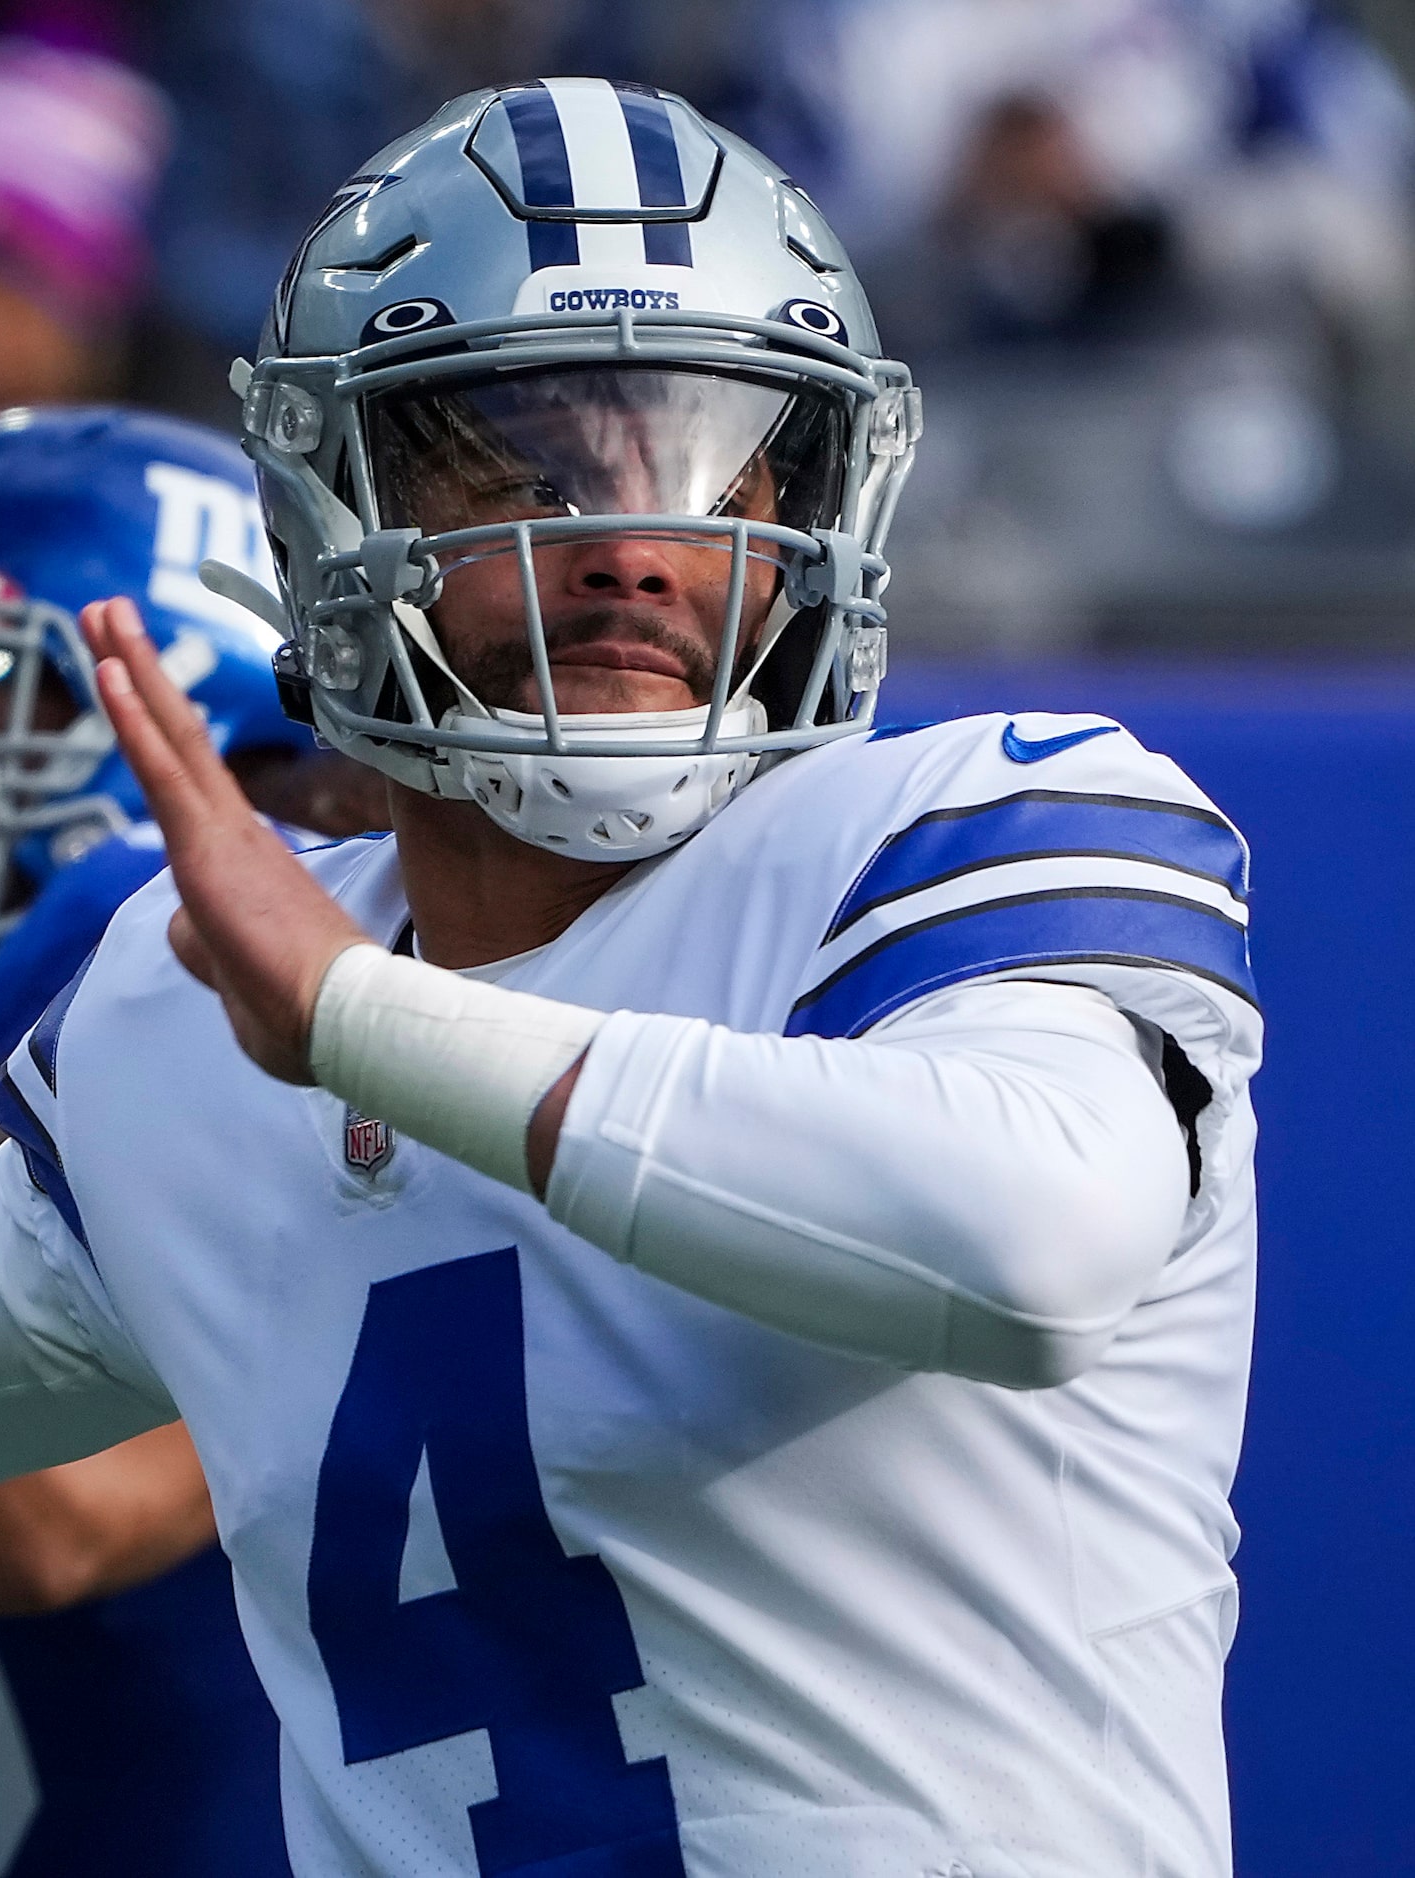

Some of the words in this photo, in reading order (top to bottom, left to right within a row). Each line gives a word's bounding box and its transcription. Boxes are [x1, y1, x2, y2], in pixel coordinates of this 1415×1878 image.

[550, 287, 679, 312] COWBOYS
[349, 1121, 384, 1161] NFL
[307, 1245, 687, 1878] 4
